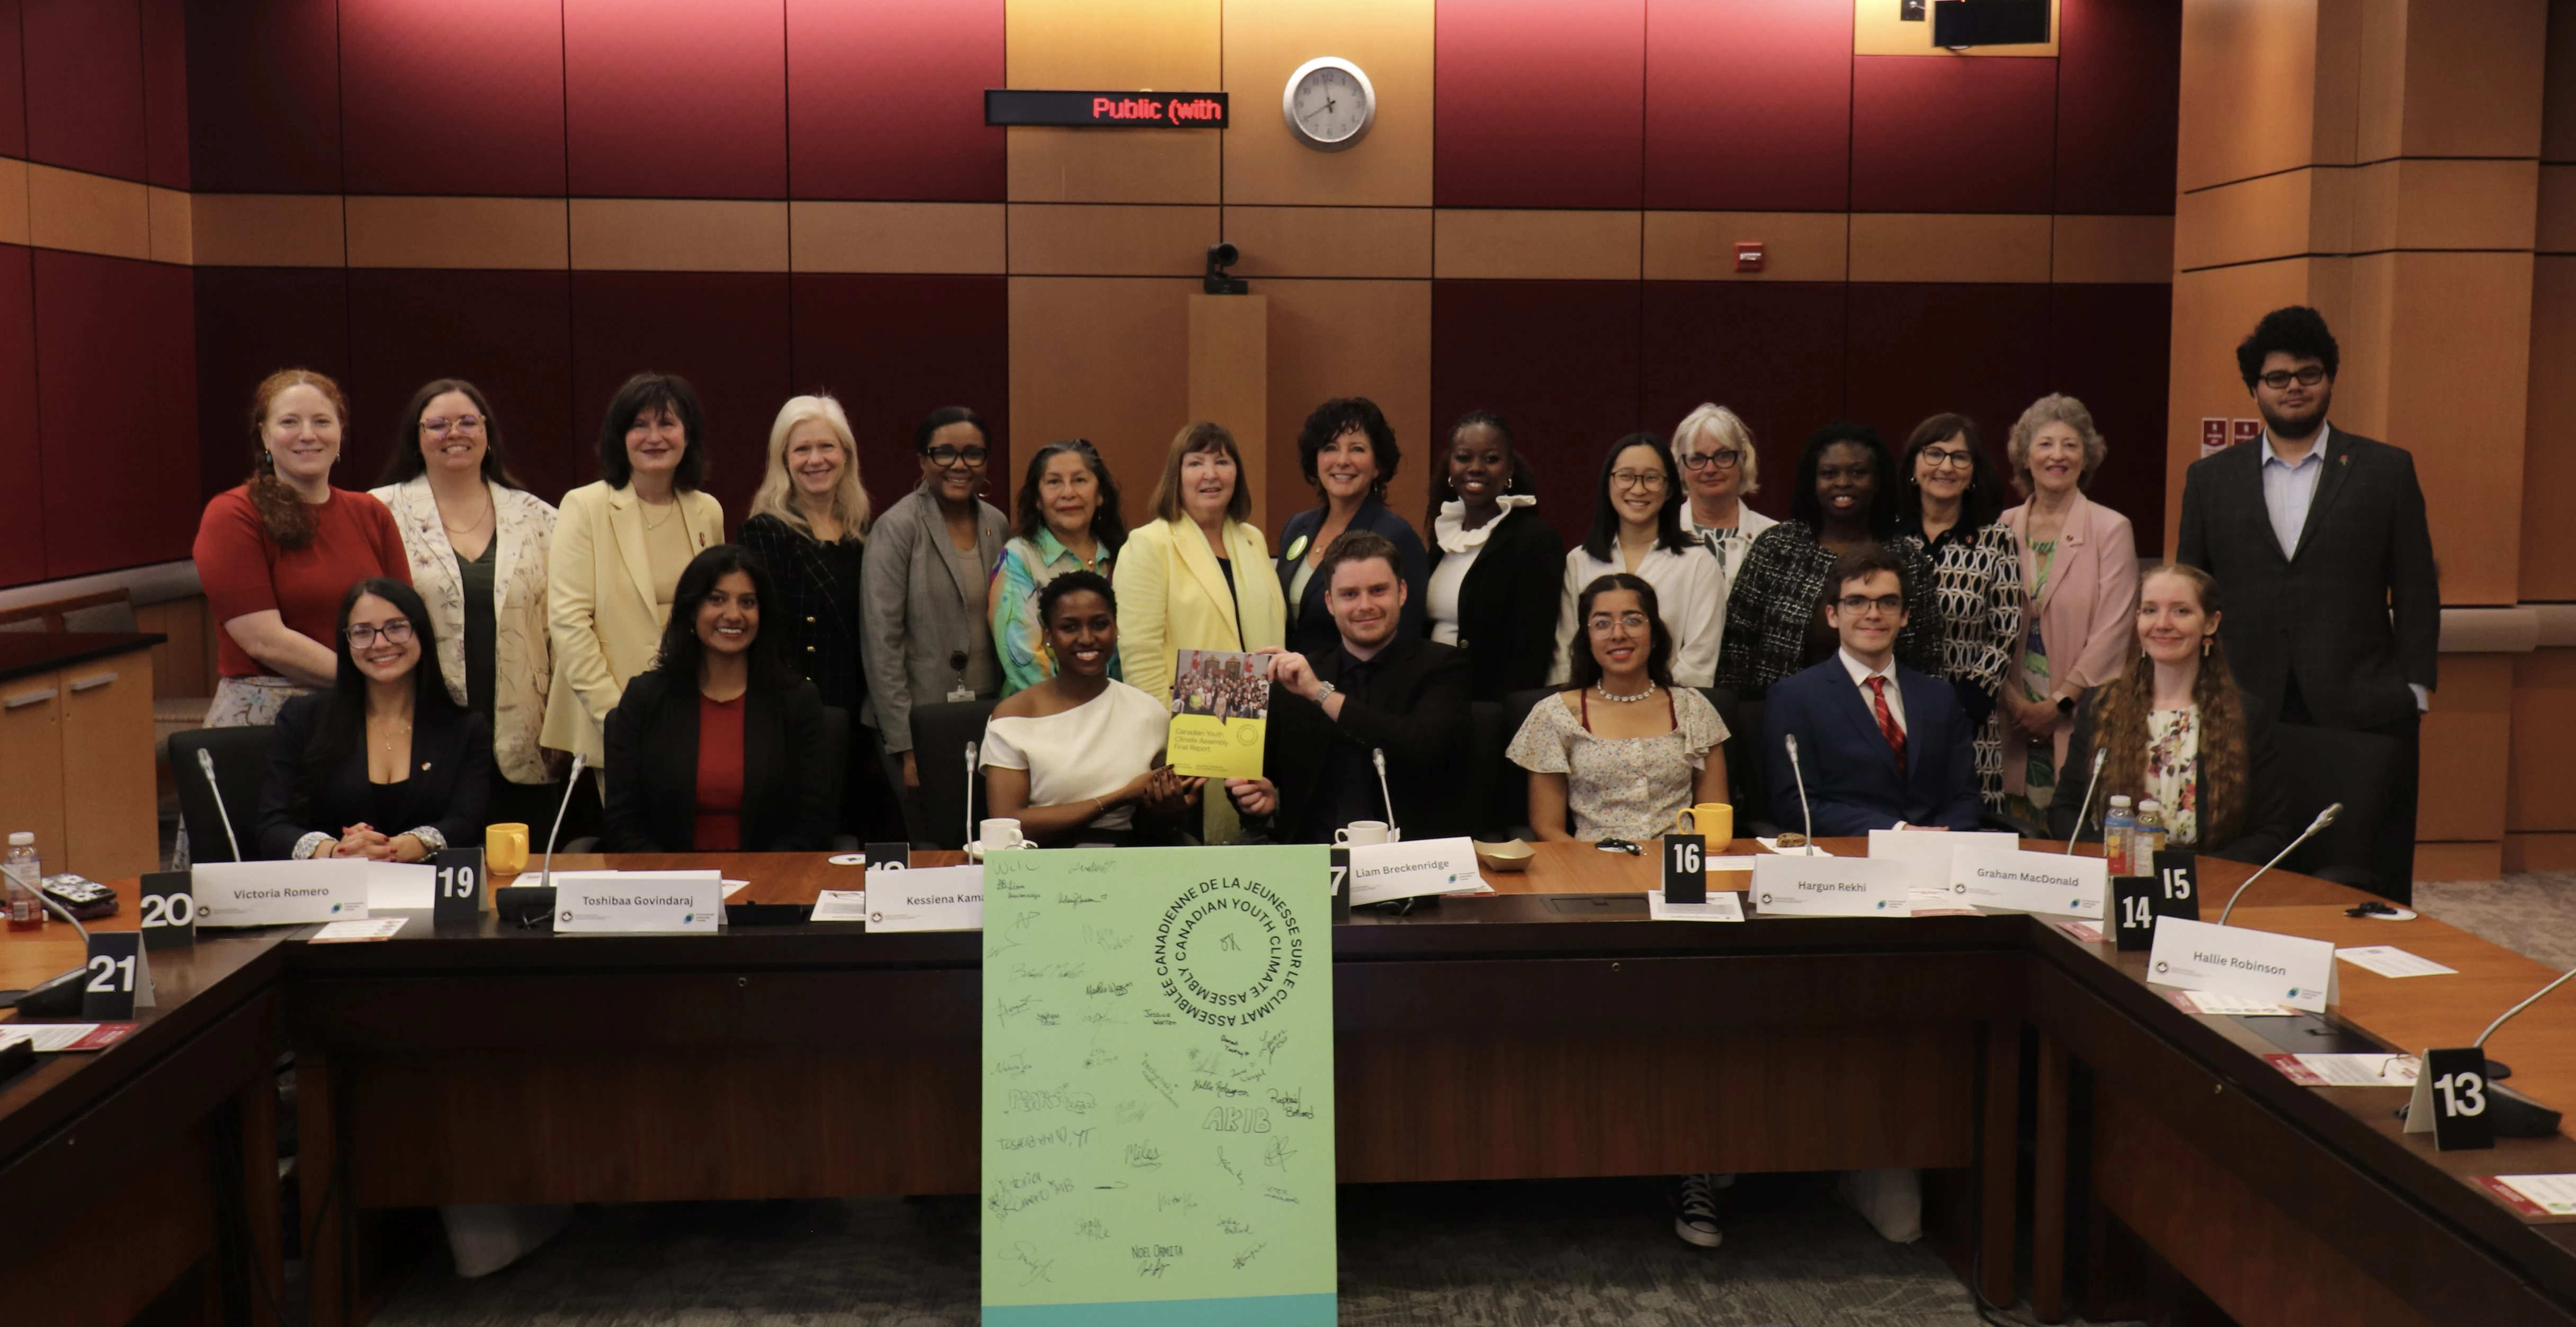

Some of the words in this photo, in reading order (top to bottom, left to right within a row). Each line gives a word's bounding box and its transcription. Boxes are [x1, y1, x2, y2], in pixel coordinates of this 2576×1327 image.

[1093, 97, 1162, 120] Public
[1168, 98, 1221, 125] (with
[1175, 728, 1204, 737] Canadian
[1189, 744, 1211, 752] Report
[1199, 737, 1228, 747] Assembly
[1356, 867, 1381, 878] Liam
[1383, 859, 1450, 875] Breckenridge
[1673, 843, 1701, 874] 16
[234, 888, 281, 899] Victoria
[284, 886, 329, 898] Romero
[438, 866, 474, 898] 19
[1199, 878, 1219, 894] DE
[1223, 877, 1240, 889] LA
[1331, 865, 1348, 896] 7
[1799, 881, 1836, 892] Hargun
[1838, 882, 1866, 892] Rekhi
[1977, 867, 2017, 881] Graham
[2020, 872, 2079, 887] MacDonald
[2162, 867, 2192, 900] 15
[141, 892, 194, 928] 20
[583, 895, 631, 905] Toshibaa
[634, 895, 693, 908] Govindaraj
[907, 895, 954, 905] Kessiena
[1231, 898, 1276, 933] YOUTH
[1244, 881, 1300, 936] JEUNESSE
[2123, 896, 2152, 929] 14
[1155, 887, 1199, 976] CANADIENNE
[1175, 898, 1228, 961] CANADIAN
[1249, 936, 1282, 998] CLIMATE
[1291, 938, 1303, 969] SUR
[2194, 951, 2228, 967] Hallie
[2230, 957, 2286, 976] Robinson
[86, 955, 136, 993] 21
[1178, 967, 1247, 1006] ASSEMBLY
[1283, 971, 1299, 989] LE
[1161, 978, 1236, 1026] ASSEMBLÉE
[1240, 989, 1287, 1025] CLIMAT
[2434, 1071, 2486, 1117] 13
[1202, 1106, 1272, 1133] AKIB
